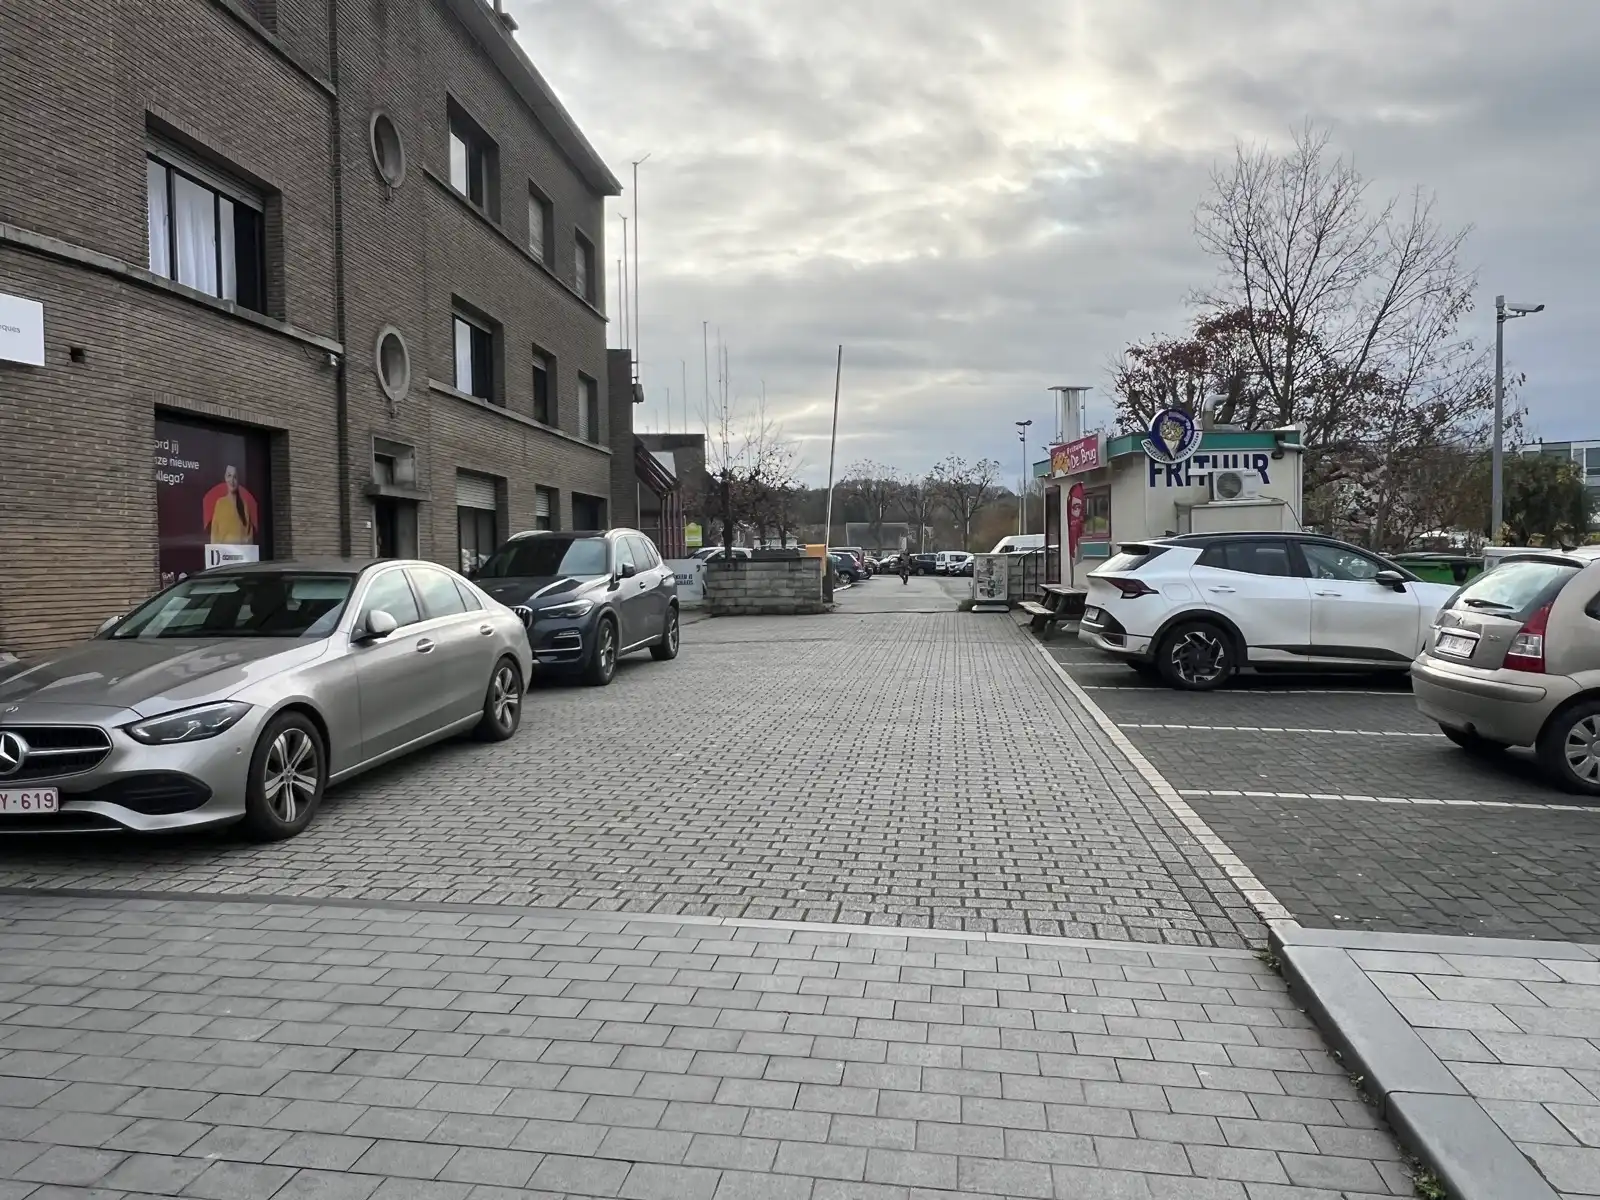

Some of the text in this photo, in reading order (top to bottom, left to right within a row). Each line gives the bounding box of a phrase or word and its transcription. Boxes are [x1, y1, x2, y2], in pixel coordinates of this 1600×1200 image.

[0, 324, 21, 334] ques
[171, 440, 179, 454] jij
[170, 456, 200, 469] nieuwe
[1070, 448, 1097, 469] De Brug
[156, 470, 185, 485] llega?
